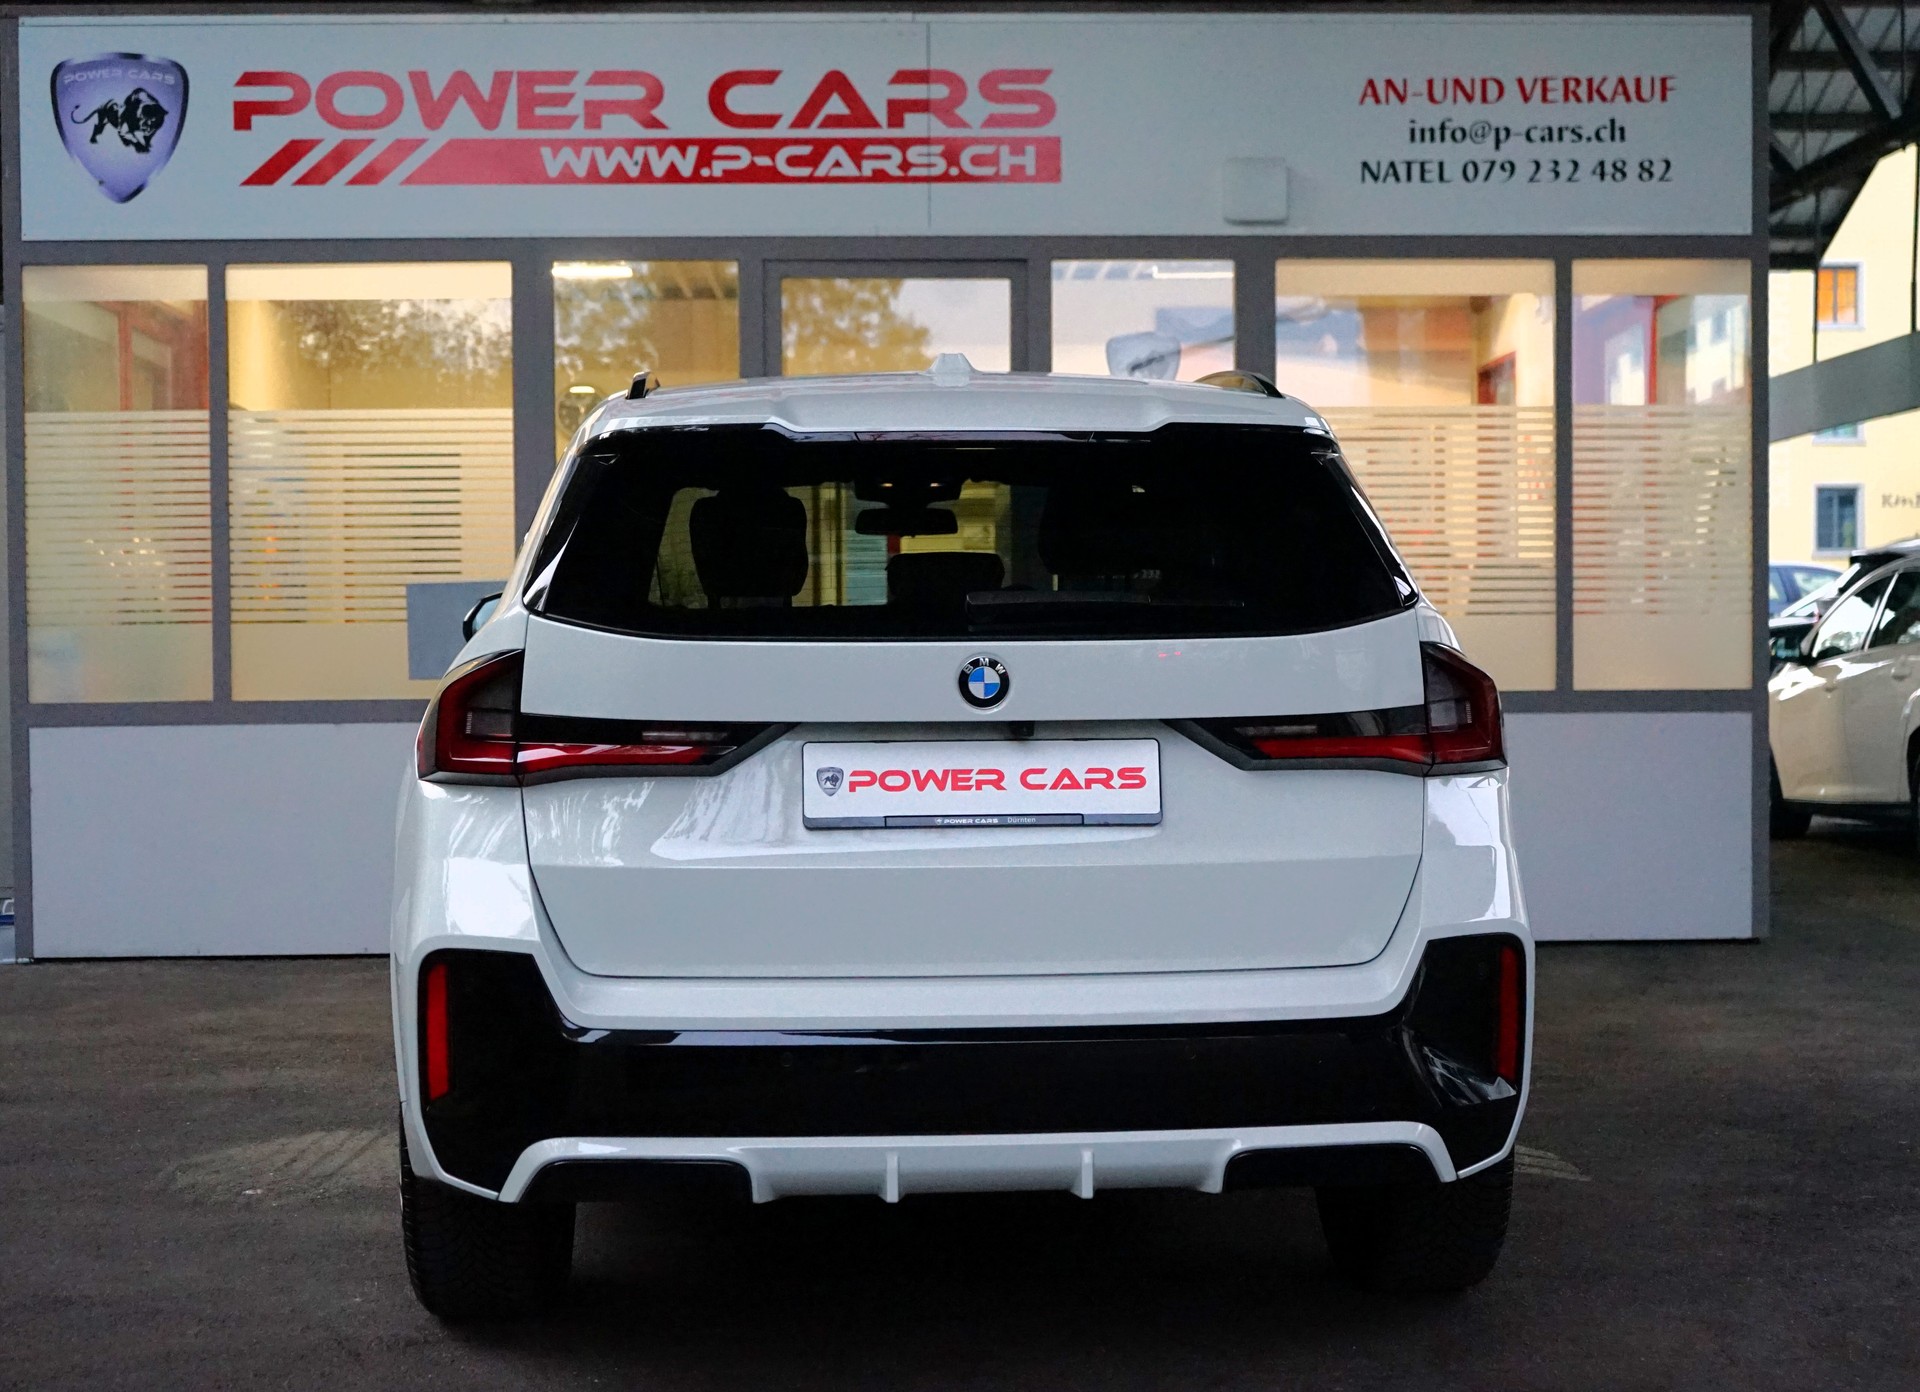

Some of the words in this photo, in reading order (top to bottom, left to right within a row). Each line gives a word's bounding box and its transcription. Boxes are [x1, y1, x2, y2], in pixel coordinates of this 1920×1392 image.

[63, 68, 122, 84] POWER
[128, 69, 175, 85] CARS
[1359, 76, 1505, 105] AN-UND
[1516, 75, 1677, 104] VERKAUF
[233, 70, 670, 131] POWER
[708, 69, 1057, 130] CARS
[1409, 118, 1627, 150] info@p-cars.ch
[540, 145, 1036, 178] WWW.P-CARS.CH
[1360, 159, 1452, 184] NATEL
[1462, 159, 1516, 184] 079
[1527, 158, 1580, 184] 232
[1591, 158, 1628, 183] 48
[1638, 158, 1673, 183] 82
[963, 657, 1006, 674] BMW
[848, 768, 1007, 792] POWER
[1020, 767, 1147, 790] CARS
